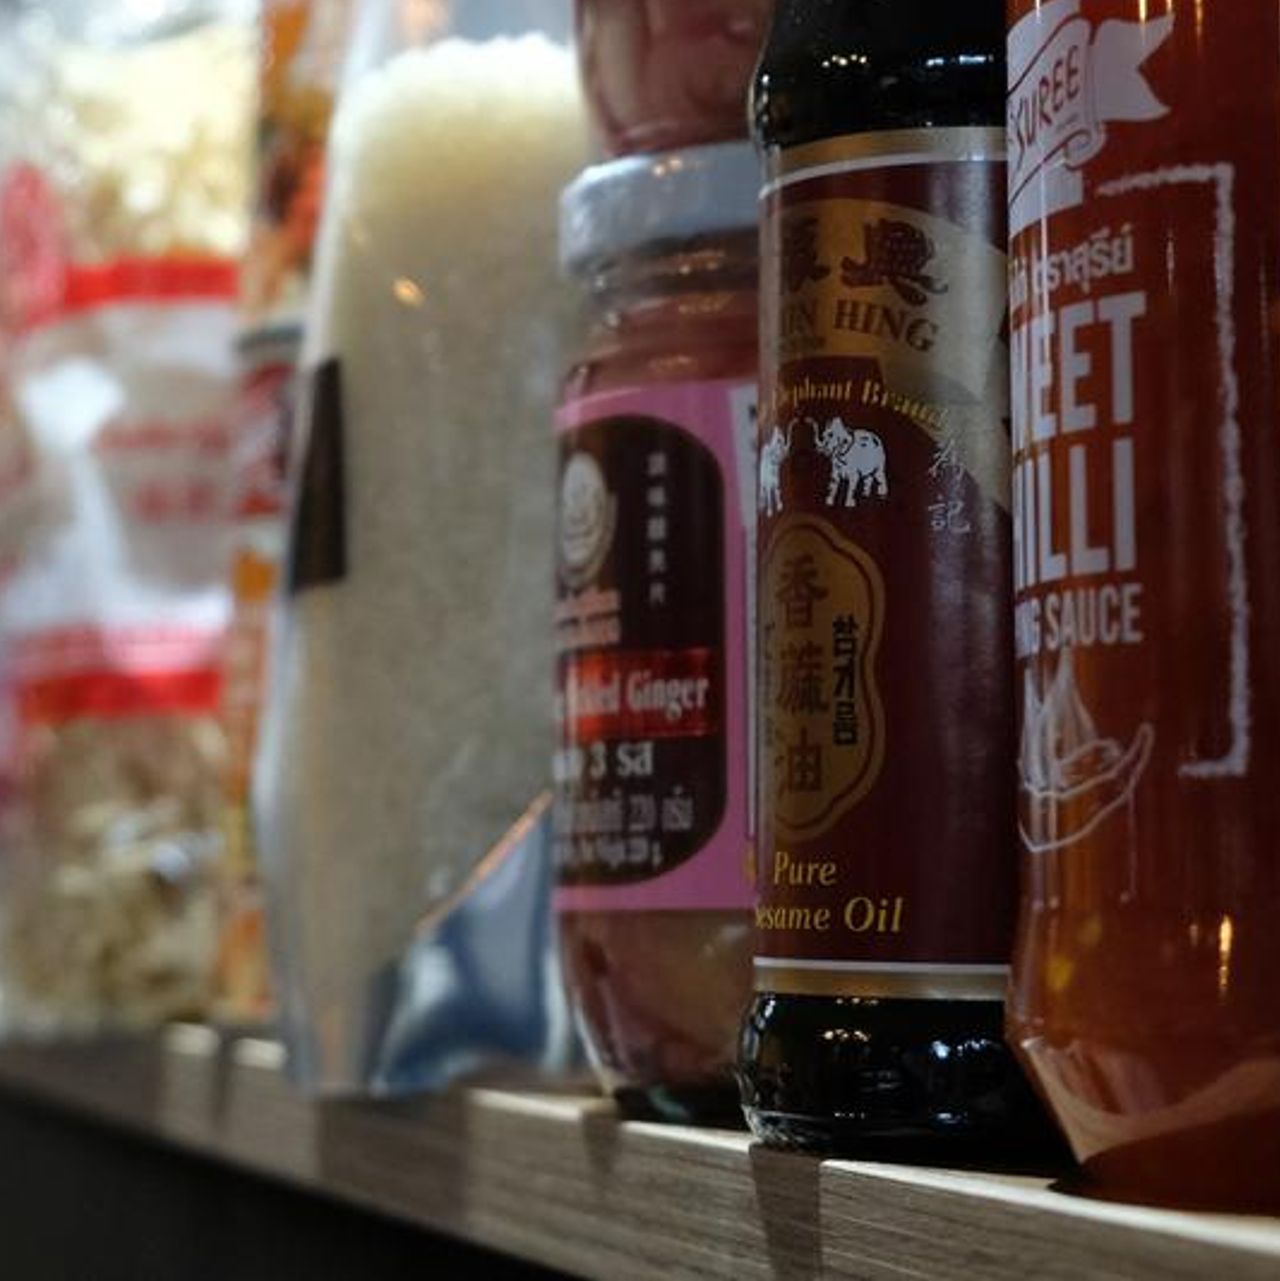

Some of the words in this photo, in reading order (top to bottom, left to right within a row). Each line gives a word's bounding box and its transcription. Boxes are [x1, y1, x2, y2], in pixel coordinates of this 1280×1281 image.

[1010, 44, 1080, 172] SUREE
[833, 298, 939, 351] HING
[1043, 582, 1145, 650] SAUCE
[626, 669, 709, 722] Ginger
[773, 850, 837, 887] Pure
[843, 895, 905, 933] Oil
